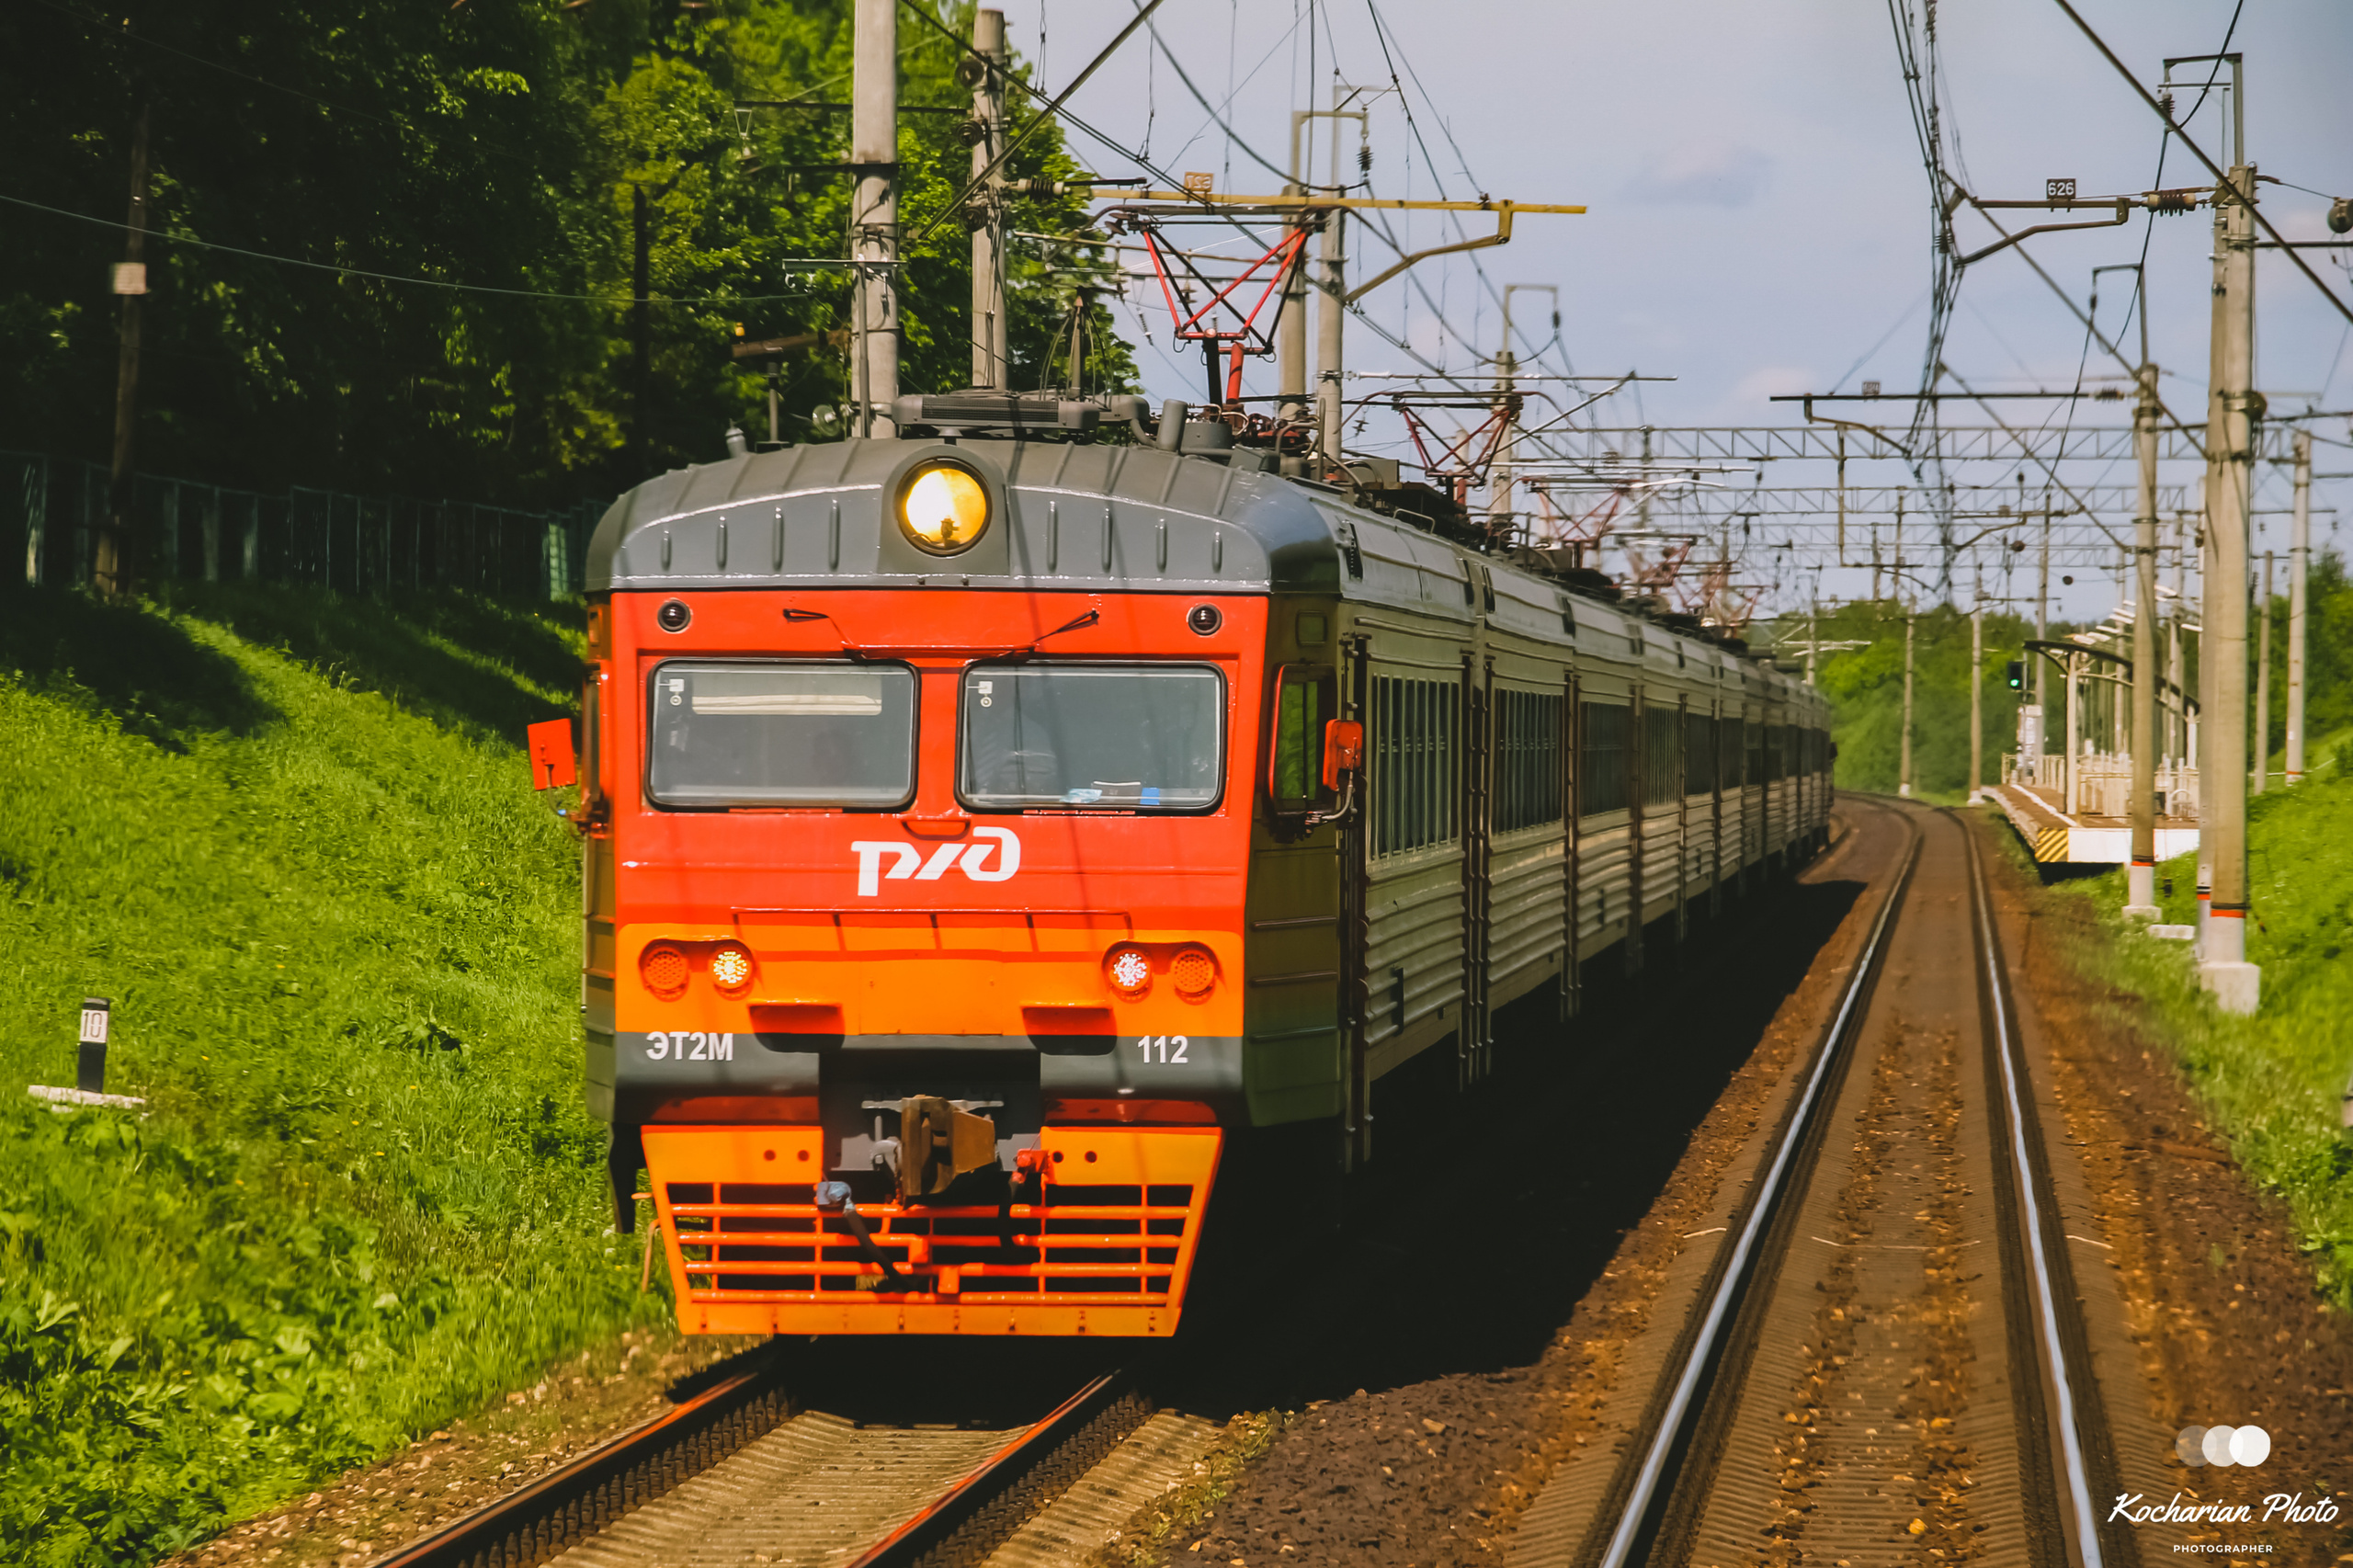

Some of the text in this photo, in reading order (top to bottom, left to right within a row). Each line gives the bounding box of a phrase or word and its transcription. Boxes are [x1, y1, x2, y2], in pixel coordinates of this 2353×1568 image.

[2047, 181, 2075, 196] 626
[83, 1011, 103, 1039] 10
[645, 1031, 733, 1062] ЭТ2М
[1137, 1035, 1188, 1063] 112
